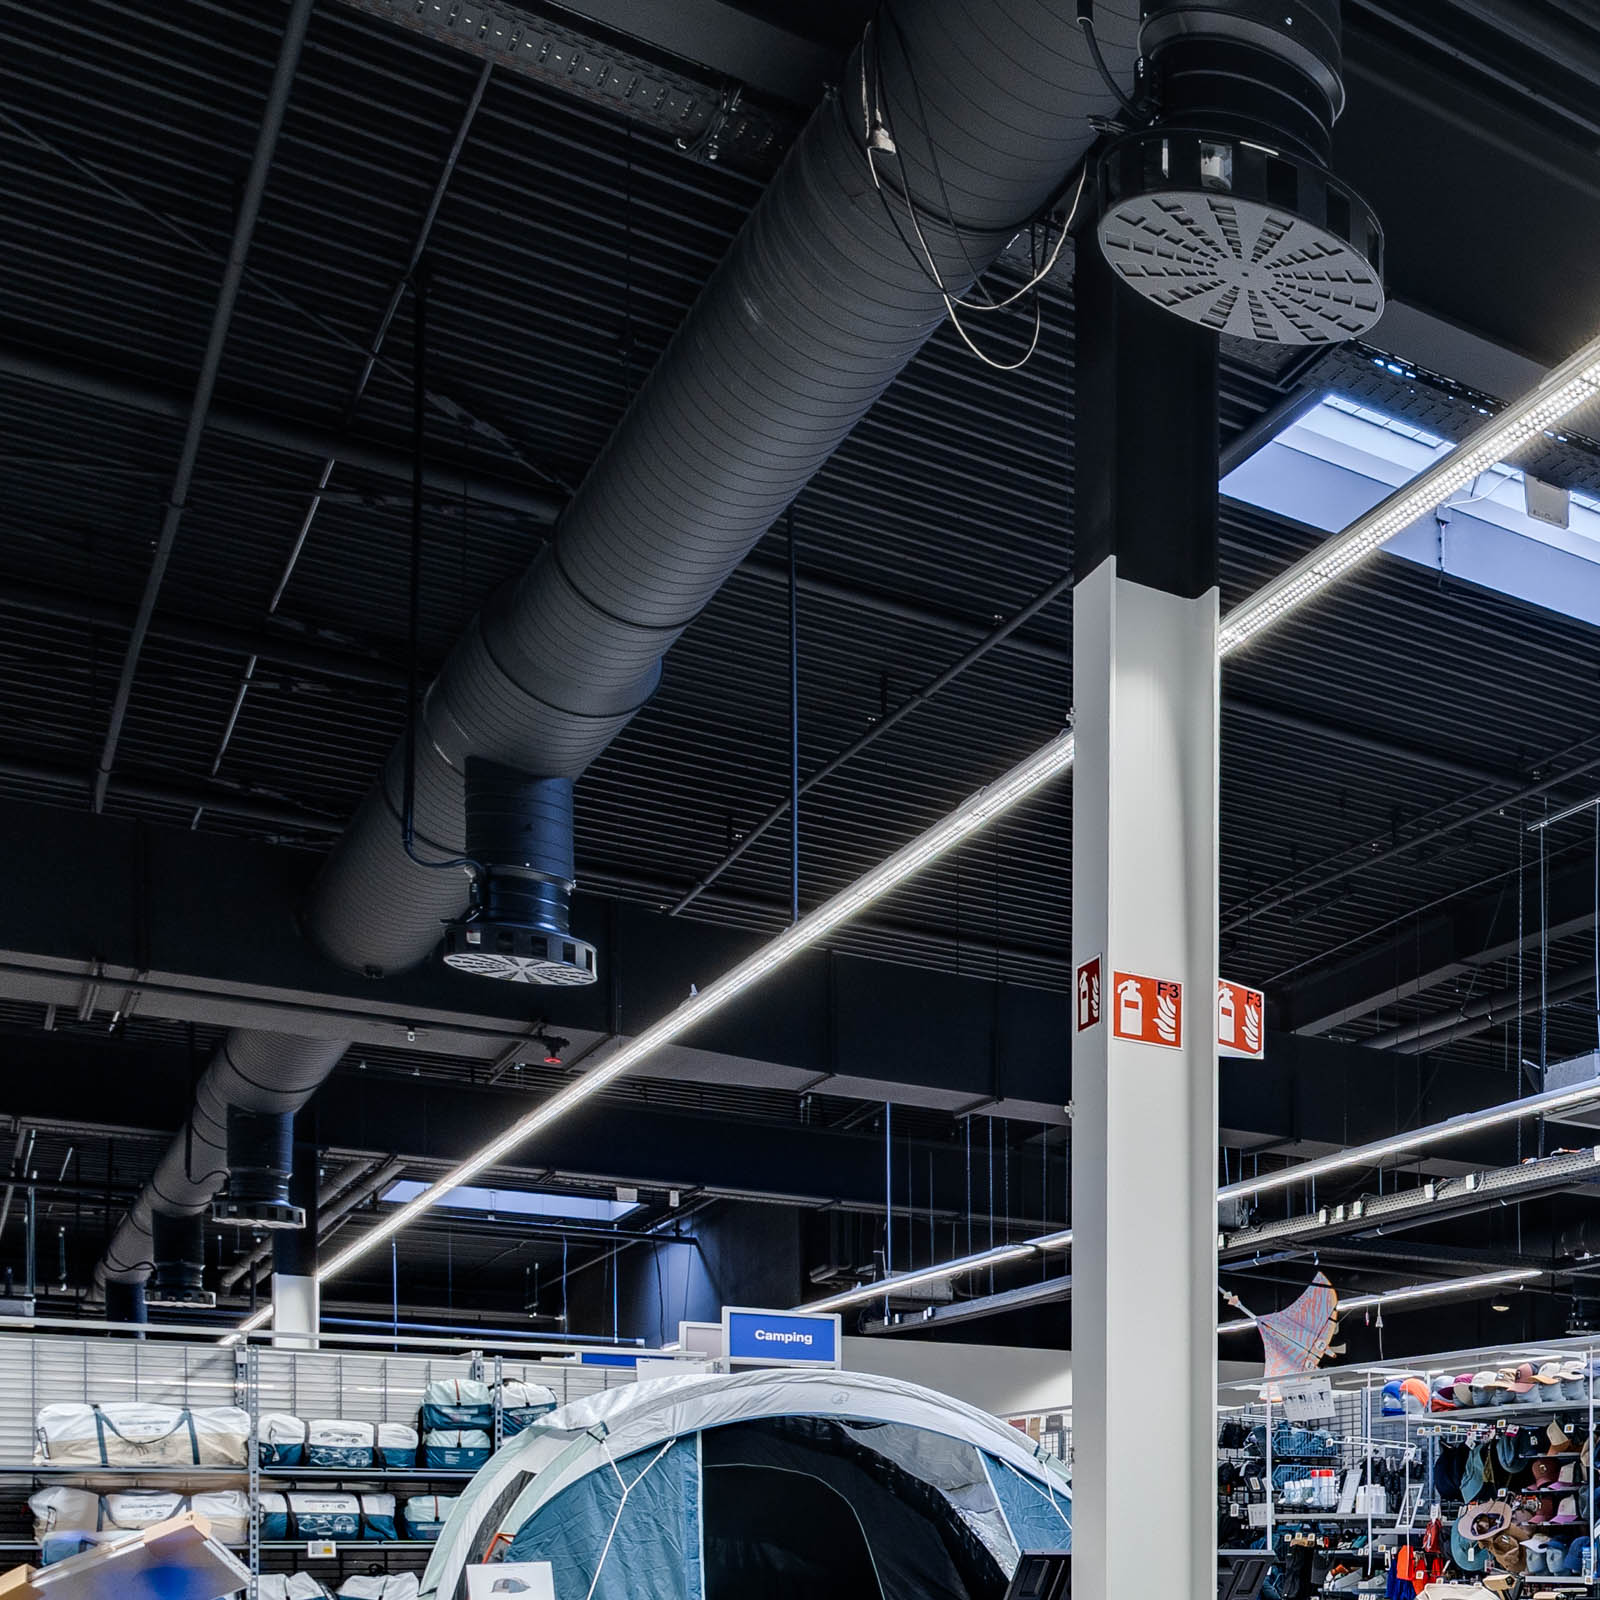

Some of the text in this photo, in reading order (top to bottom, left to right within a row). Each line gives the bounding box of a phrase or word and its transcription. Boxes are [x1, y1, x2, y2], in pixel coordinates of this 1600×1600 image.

[1157, 981, 1179, 999] F3
[1246, 991, 1262, 1008] F3
[754, 1329, 813, 1345] Camping
